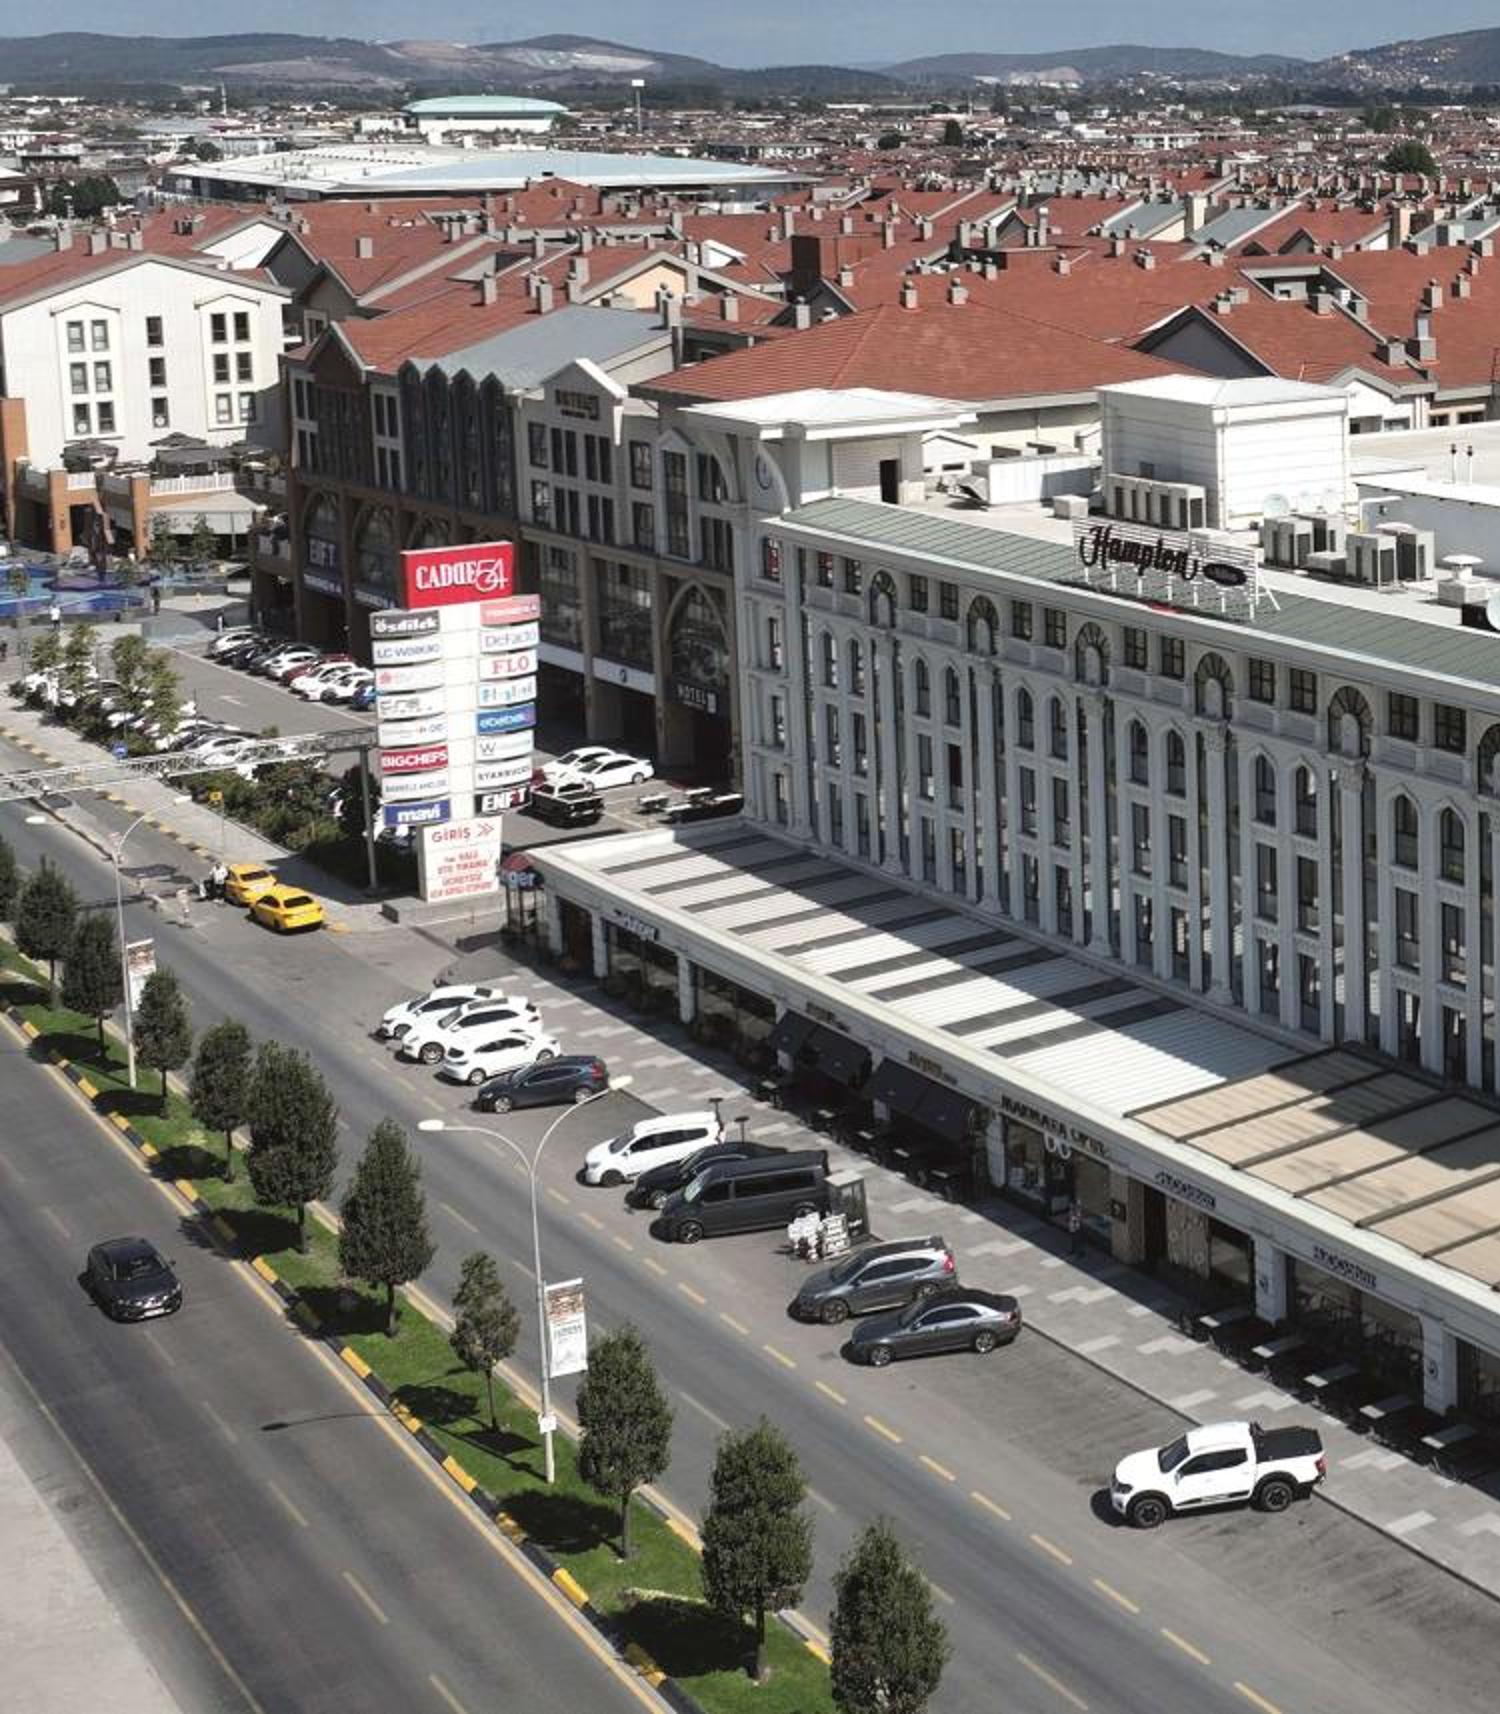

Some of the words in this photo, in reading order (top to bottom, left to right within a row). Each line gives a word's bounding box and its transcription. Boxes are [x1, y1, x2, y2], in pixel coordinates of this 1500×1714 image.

[1079, 525, 1199, 581] Hampton
[492, 655, 530, 675] FLO
[397, 804, 442, 823] mavi
